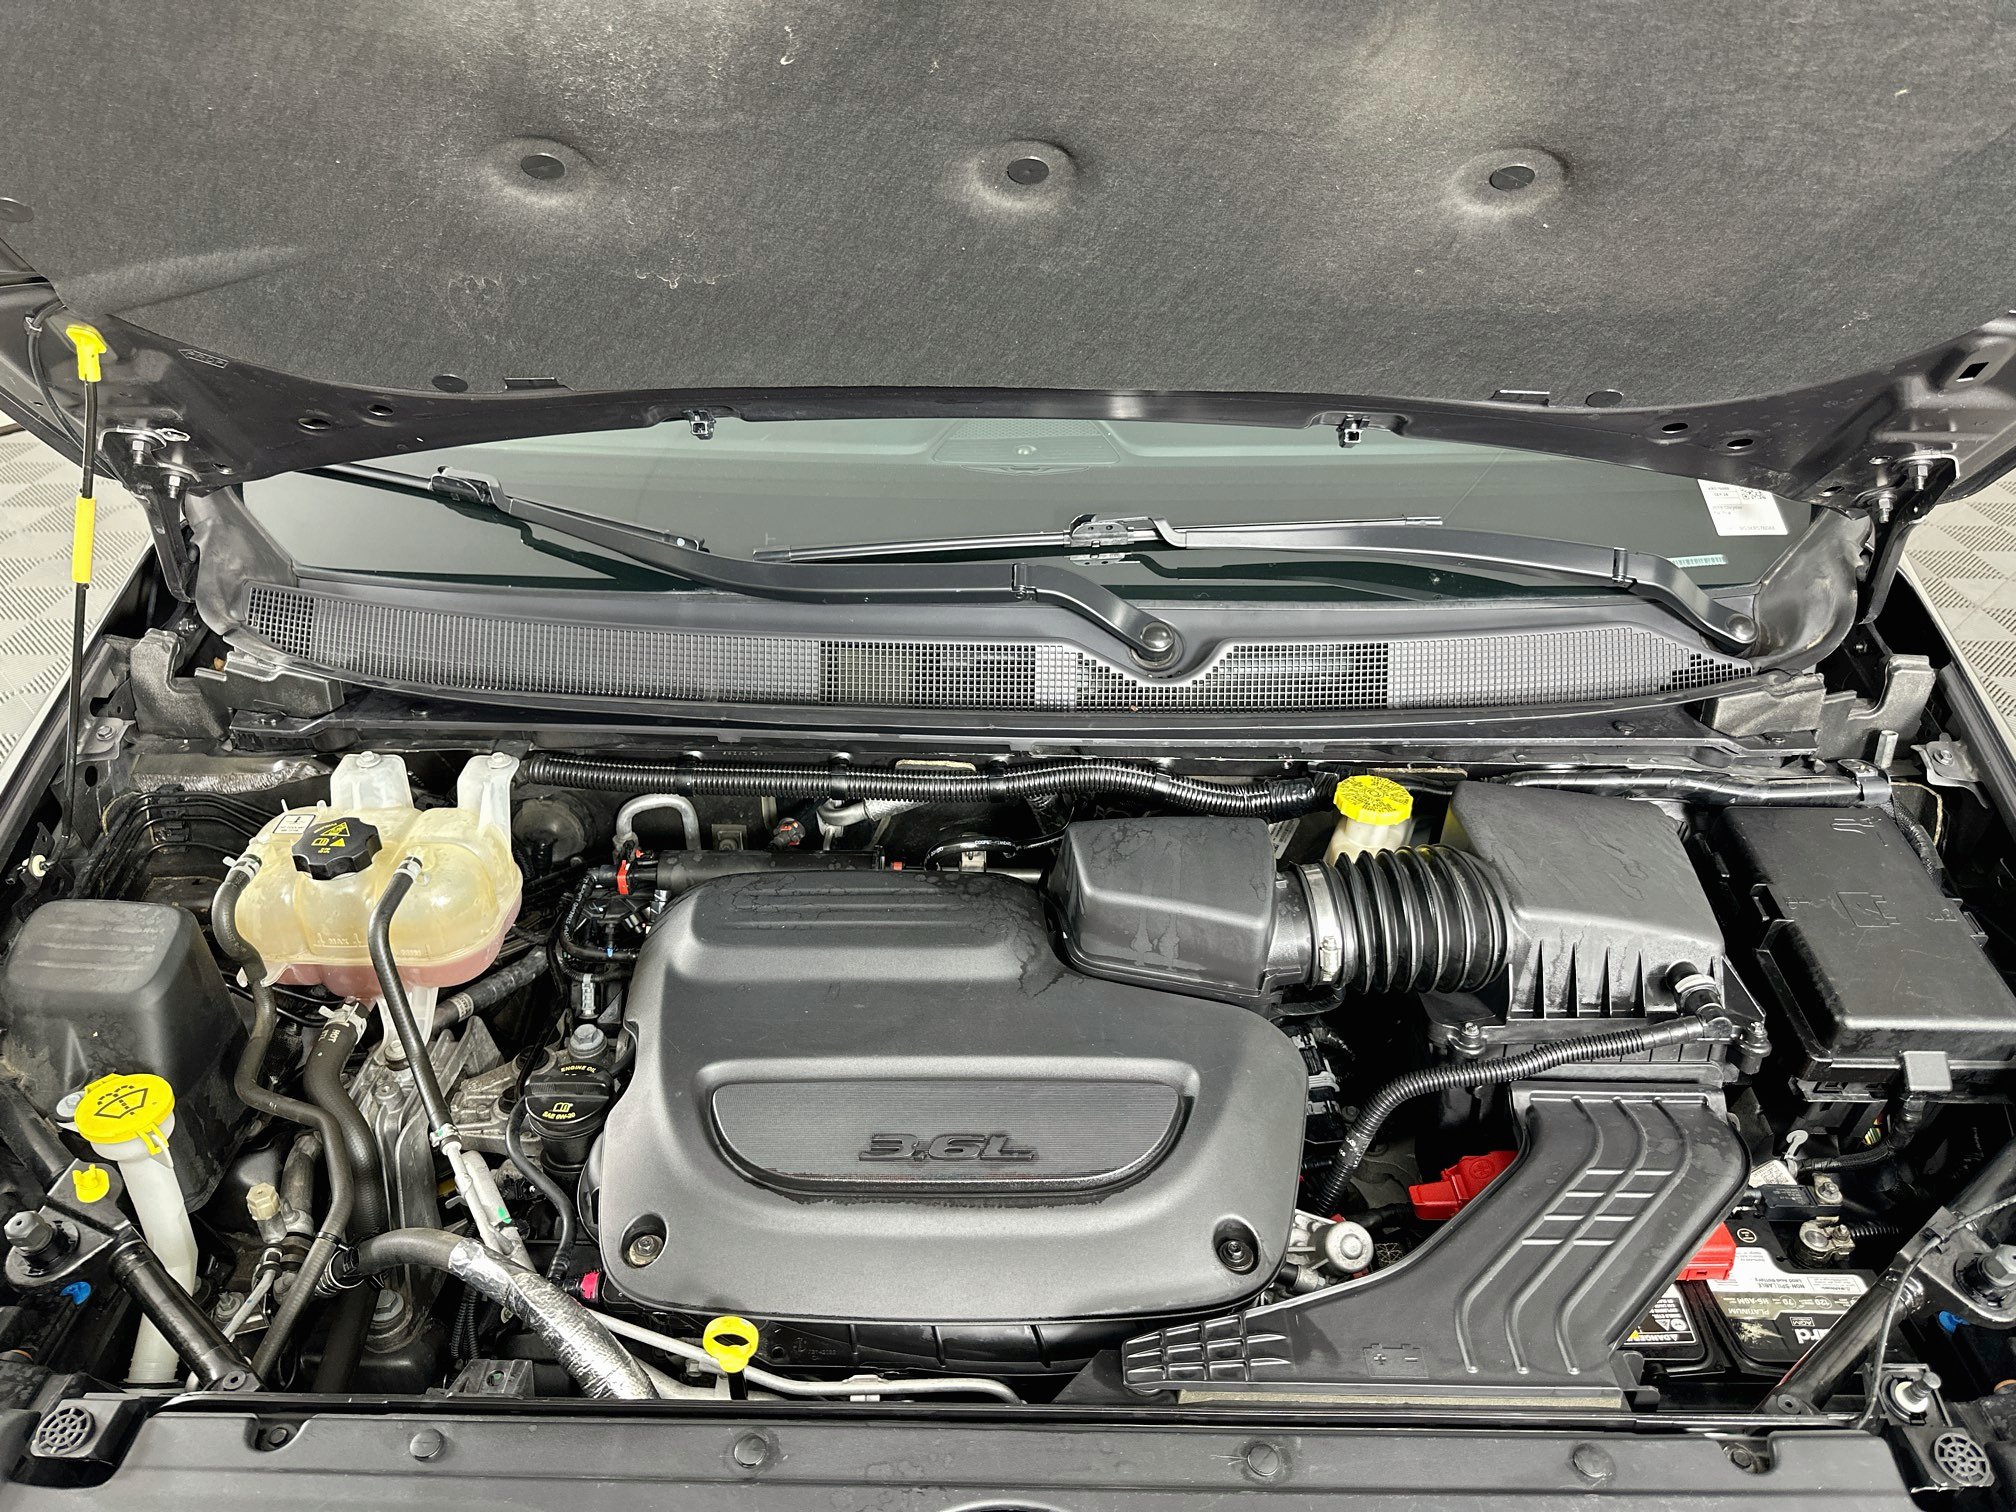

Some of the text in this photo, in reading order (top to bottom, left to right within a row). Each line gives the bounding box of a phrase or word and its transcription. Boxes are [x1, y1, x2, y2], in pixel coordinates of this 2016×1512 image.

[328, 1029, 341, 1043] HOT
[560, 1065, 587, 1073] ENGINE
[858, 1132, 1036, 1162] 3.6L
[1728, 1307, 1770, 1316] PLATINUM
